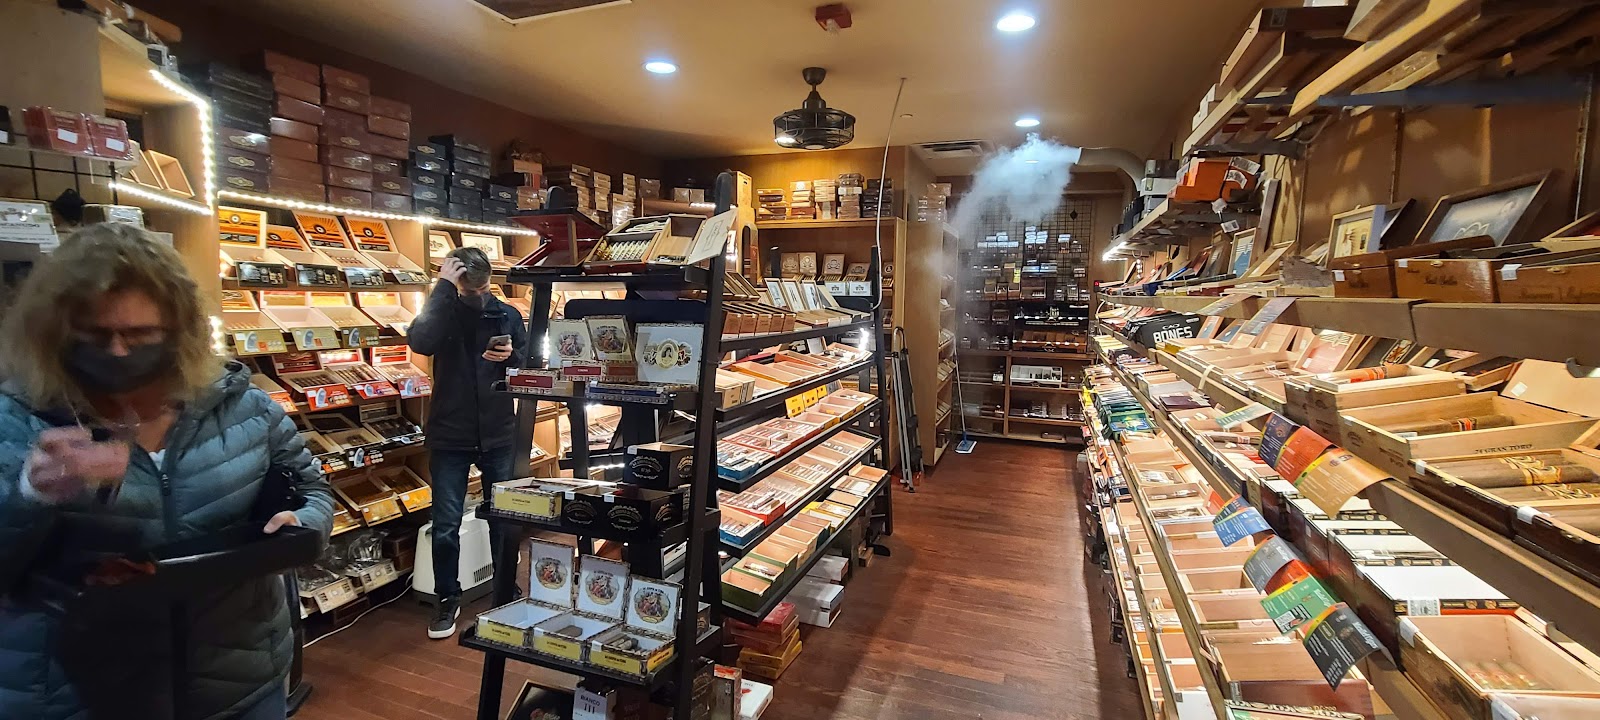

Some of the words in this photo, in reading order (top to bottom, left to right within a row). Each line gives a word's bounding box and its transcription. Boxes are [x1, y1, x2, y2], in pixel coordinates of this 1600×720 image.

[1153, 326, 1193, 343] BONES
[580, 694, 601, 707] BIANCO
[583, 703, 596, 715] III
